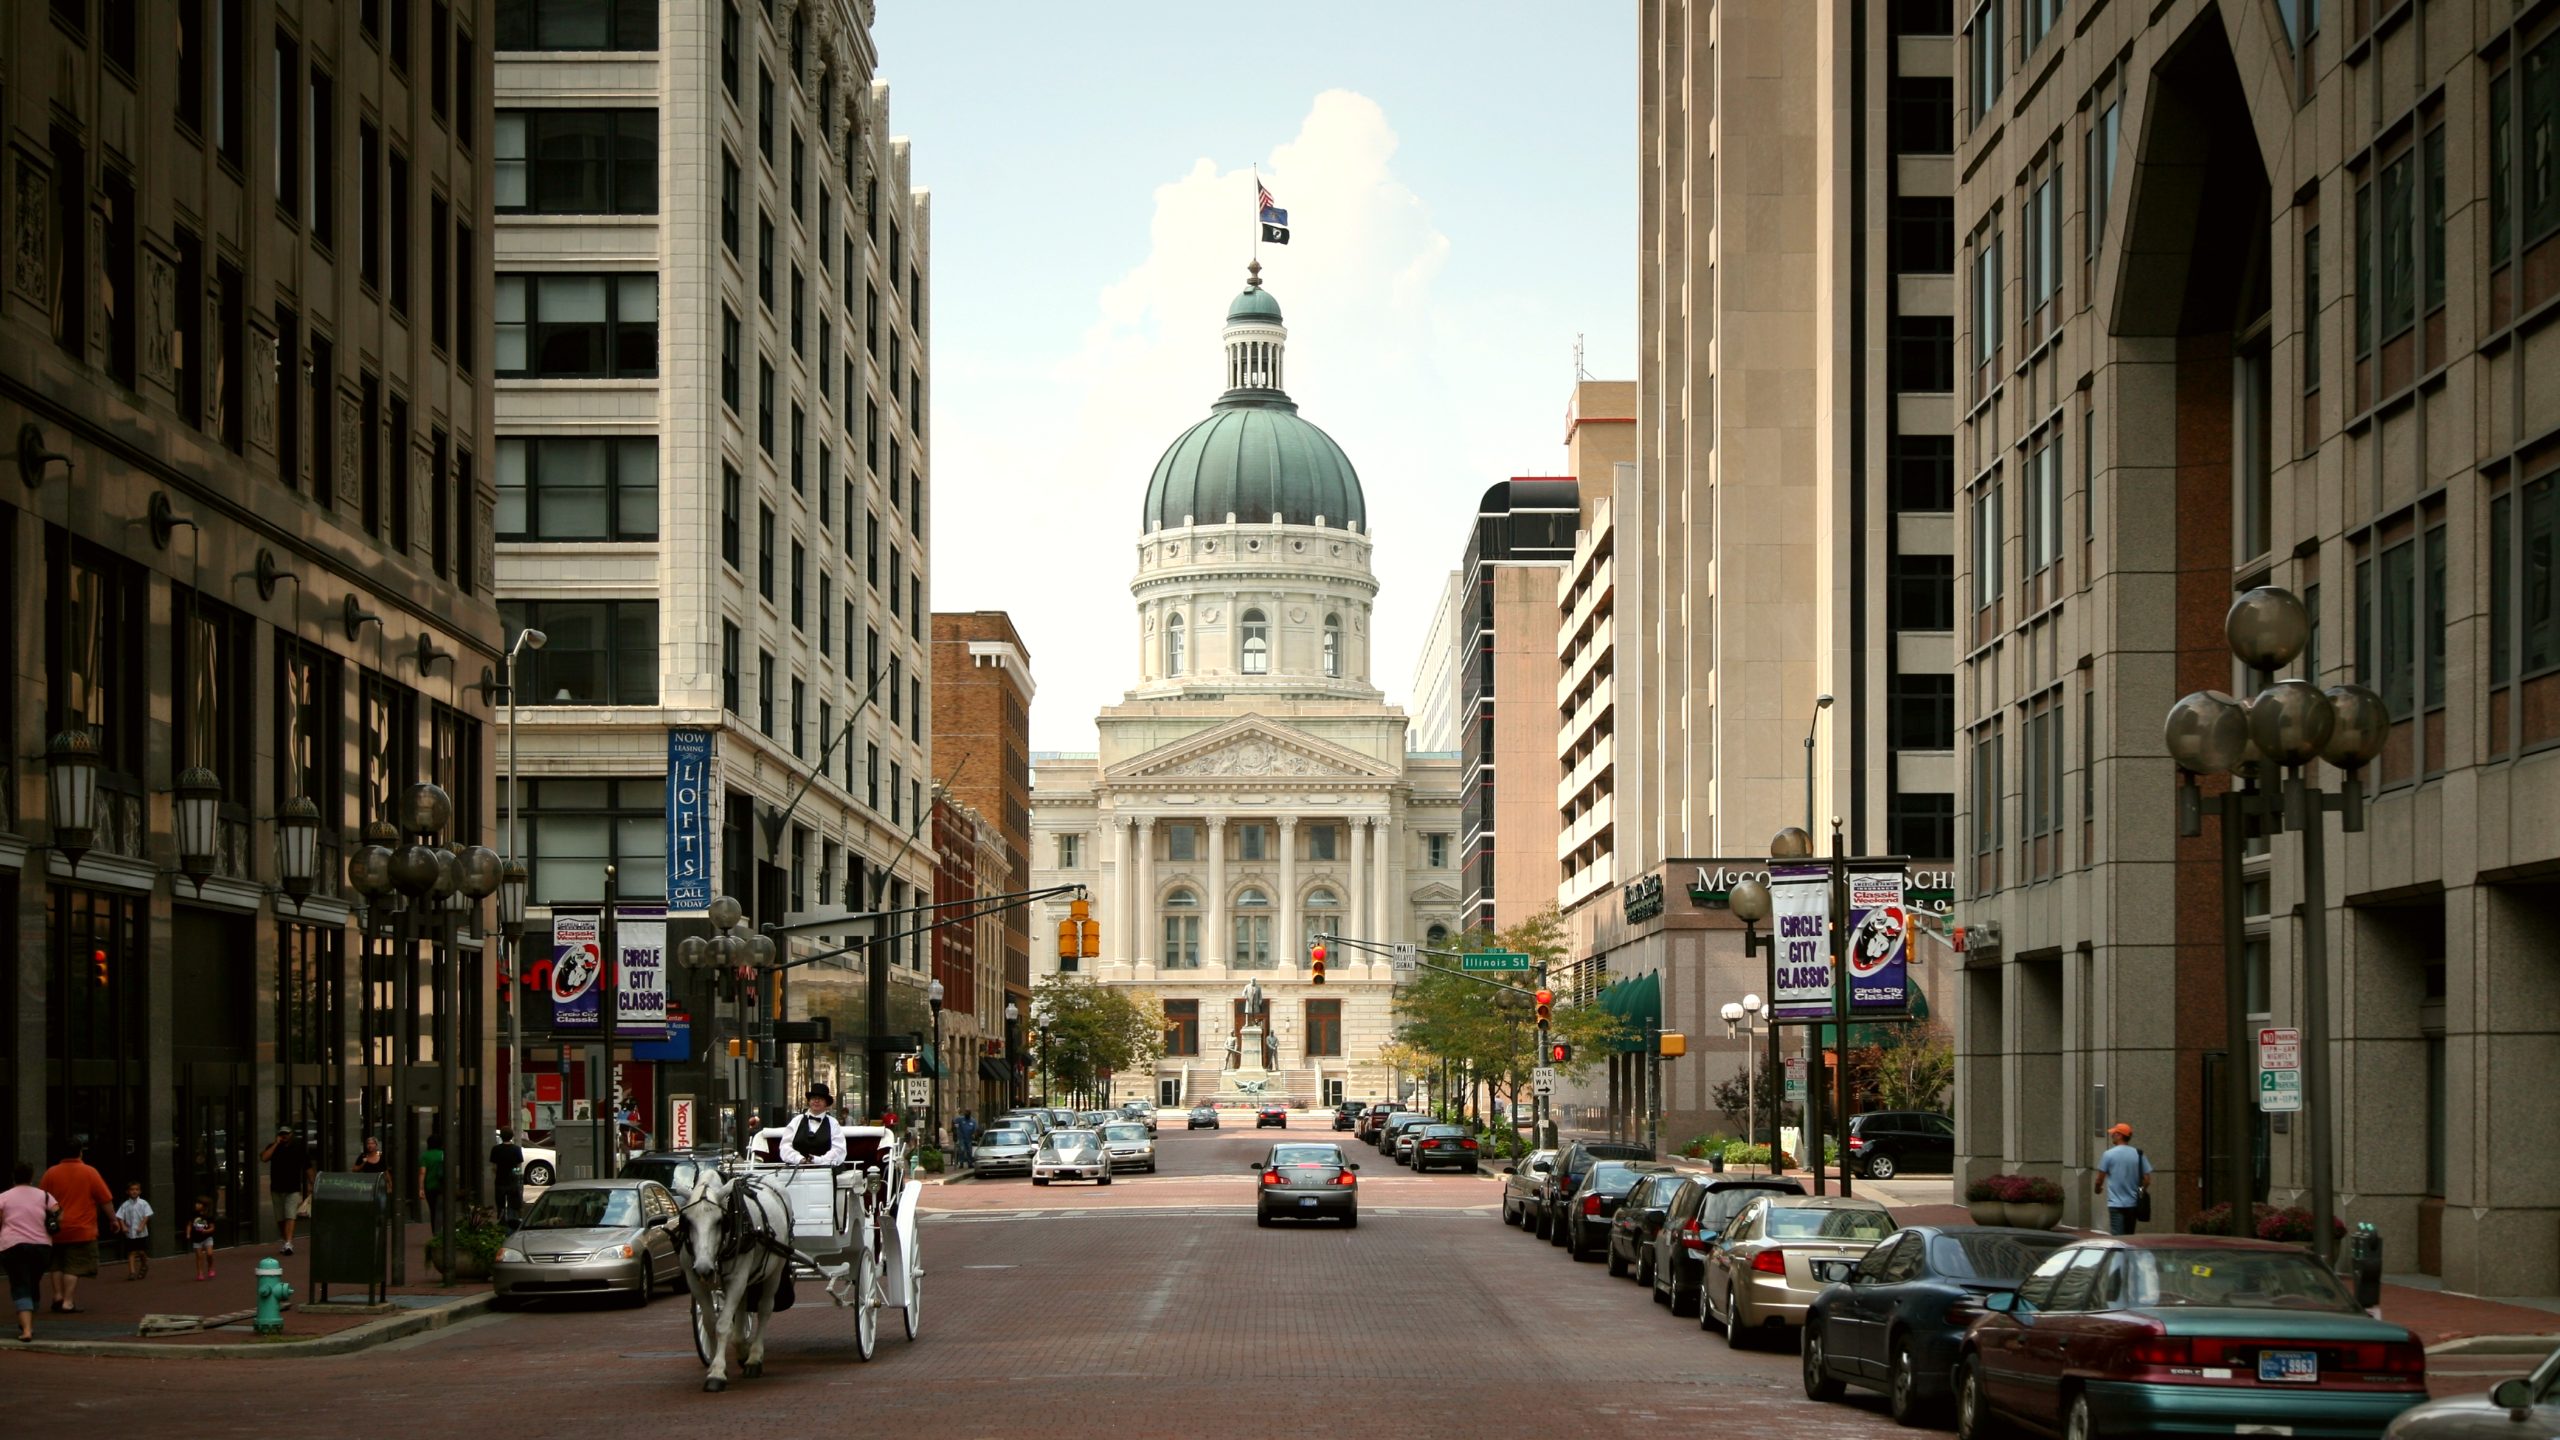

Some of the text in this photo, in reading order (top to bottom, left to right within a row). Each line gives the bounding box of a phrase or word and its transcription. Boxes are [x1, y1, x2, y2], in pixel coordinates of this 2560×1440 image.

[675, 733, 705, 743] NOW
[679, 764, 696, 876] LOFTS
[675, 888, 703, 898] CALL
[676, 900, 703, 908] TODAY
[1780, 915, 1823, 937] CIRCLE
[1396, 945, 1414, 953] WAIT
[1789, 941, 1817, 963] CITY
[623, 949, 660, 967] CIRCLE
[1465, 957, 1525, 967] Illinois St
[1395, 961, 1413, 969] SIGNAL
[630, 971, 654, 989] CITY
[1777, 966, 1829, 989] CLASSIC
[619, 992, 663, 1011] CLASSIC
[2263, 1033, 2274, 1043] NO
[1535, 1078, 1553, 1086] WAY
[2263, 1073, 2273, 1089] 2
